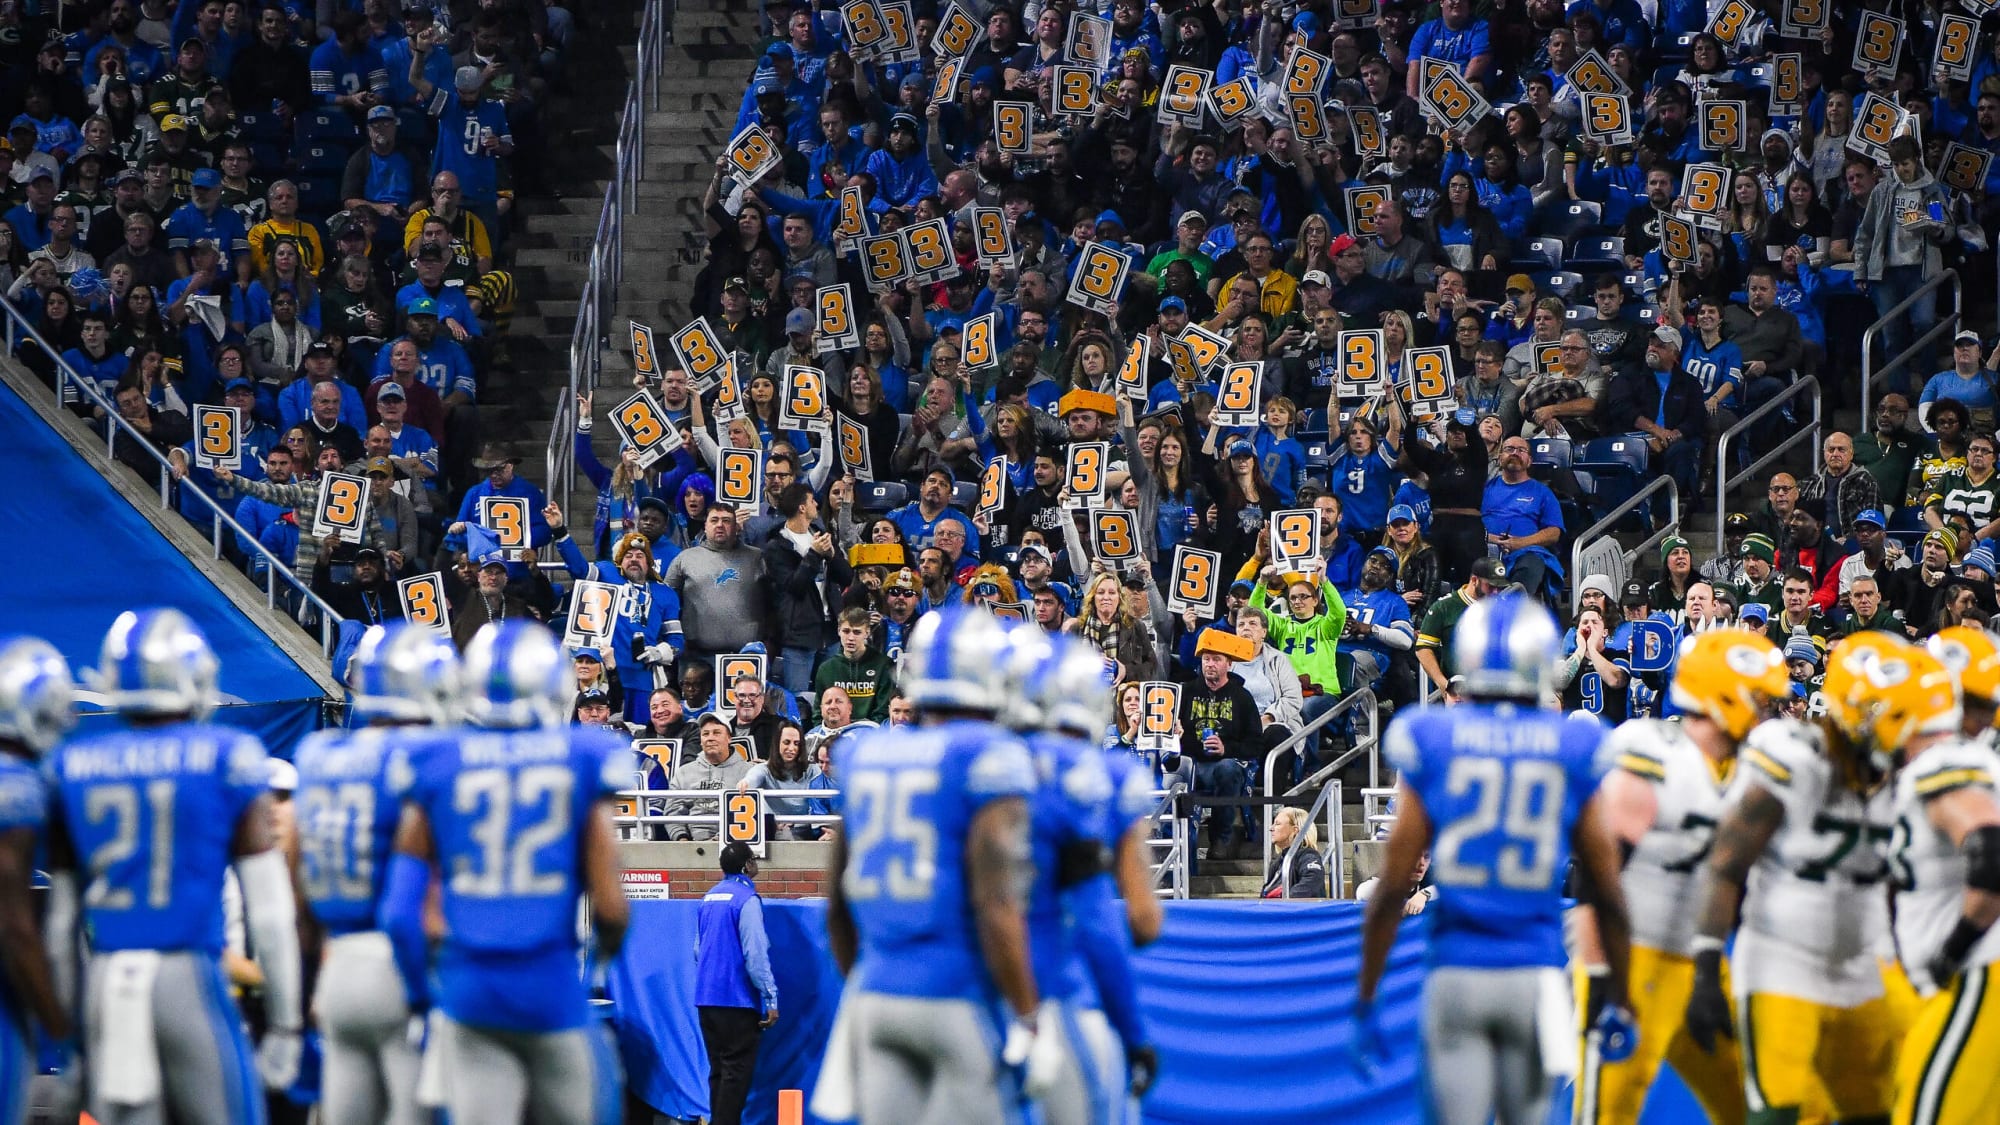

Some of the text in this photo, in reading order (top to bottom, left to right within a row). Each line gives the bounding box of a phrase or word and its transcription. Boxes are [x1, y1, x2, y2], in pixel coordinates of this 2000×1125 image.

[848, 1, 883, 45] 3
[943, 14, 975, 54] 3
[1075, 20, 1104, 60] 3
[1714, 1, 1746, 43] 3
[1865, 19, 1896, 61] 3
[1941, 21, 1970, 63] 3
[936, 62, 958, 99] 3
[1062, 71, 1091, 110] 3
[1170, 71, 1203, 116] 3
[1288, 54, 1320, 94] 3
[1778, 59, 1798, 100] 3
[1214, 82, 1248, 116] 3
[1292, 97, 1320, 137] 3
[1432, 78, 1471, 119] 3
[1591, 96, 1622, 131] 3
[999, 107, 1024, 148] 3
[1354, 110, 1381, 150] 3
[1708, 105, 1738, 145] 3
[1863, 103, 1898, 144] 3
[733, 135, 770, 172] 3
[1943, 152, 1983, 191] 3
[1689, 171, 1721, 212] 3
[841, 192, 862, 235] 3
[980, 213, 1006, 254] 3
[868, 239, 902, 279] 3
[910, 226, 945, 269] 3
[1665, 220, 1691, 259] 3
[1083, 252, 1120, 297] 3
[821, 291, 848, 334] 3
[633, 330, 654, 372] 3
[681, 329, 718, 373] 3
[966, 321, 989, 365] 3
[1119, 339, 1143, 382] 3
[1169, 342, 1197, 382] 3
[1346, 336, 1376, 380] 3
[791, 374, 823, 416] 3
[1224, 368, 1254, 409] 3
[1415, 353, 1446, 398] 3
[203, 412, 232, 455] 3
[621, 401, 663, 446] 3
[841, 422, 863, 466] 3
[724, 454, 753, 498] 3
[979, 463, 1000, 508] 3
[1072, 448, 1099, 492] 3
[1348, 470, 1364, 494] 9
[327, 480, 360, 524] 3
[490, 502, 522, 545] 3
[1099, 515, 1132, 556] 3
[1281, 515, 1311, 556] 3
[1179, 554, 1211, 600] 3
[407, 581, 438, 624] 3
[577, 587, 612, 630] 3
[1629, 620, 1675, 671] D
[835, 682, 876, 695] PACKERS
[1580, 671, 1605, 715] 9
[1146, 687, 1175, 733] 3
[450, 764, 574, 895] 32
[729, 792, 757, 841] 3
[843, 767, 938, 898] 25
[1432, 756, 1567, 889] 29
[84, 782, 175, 908] 21
